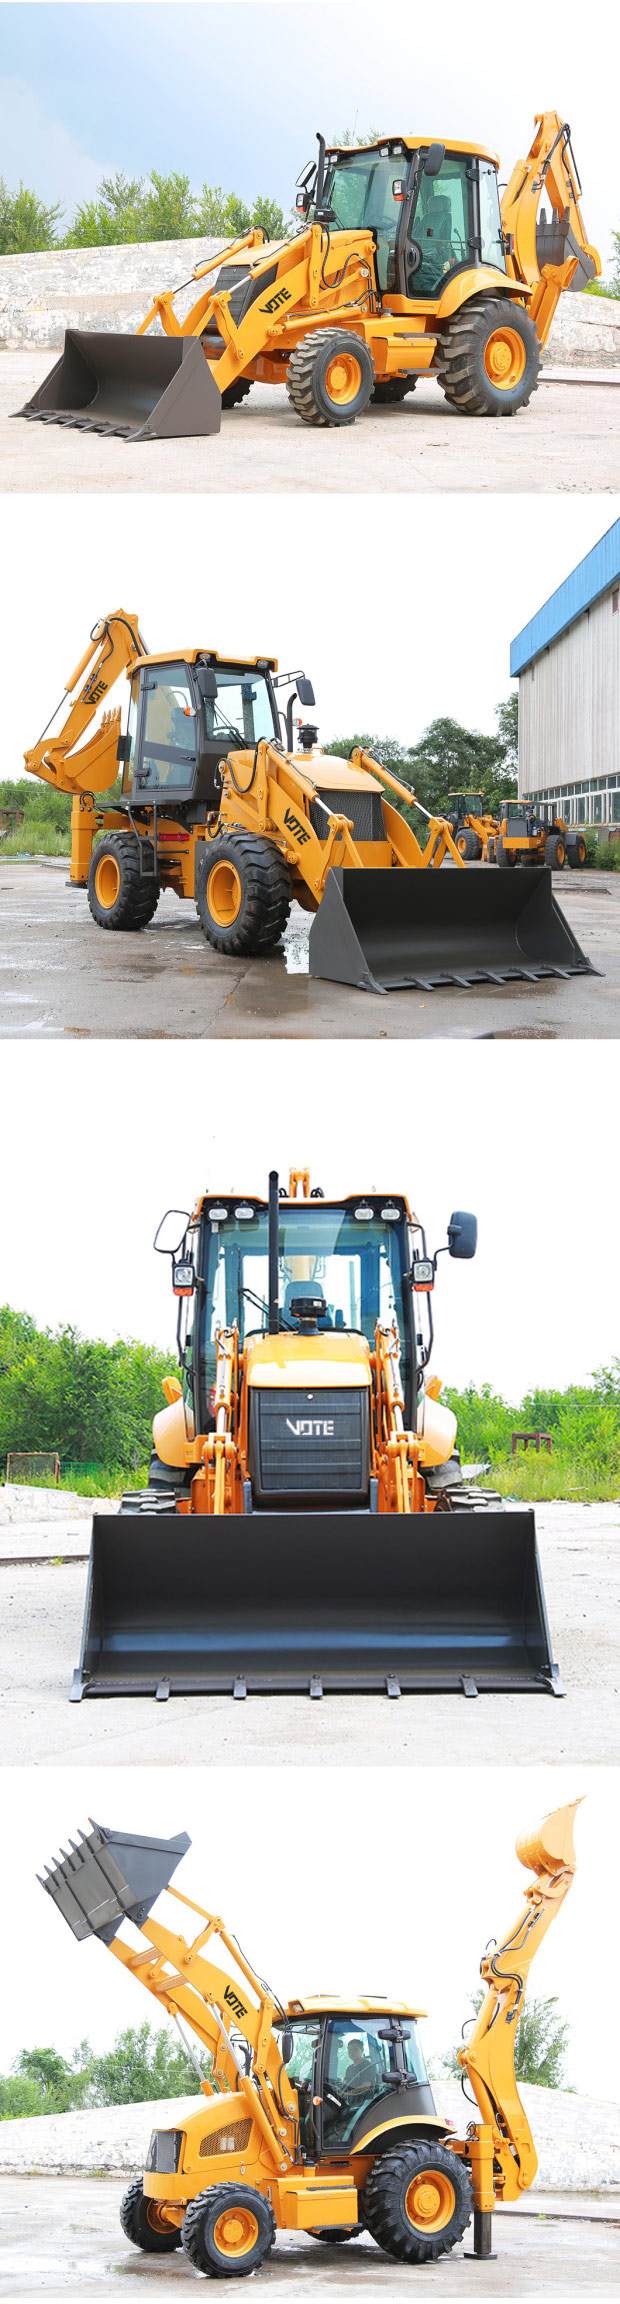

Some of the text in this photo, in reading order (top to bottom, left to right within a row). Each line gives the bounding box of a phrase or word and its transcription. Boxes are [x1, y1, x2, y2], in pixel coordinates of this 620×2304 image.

[258, 287, 292, 314] VOTE
[84, 680, 109, 704] VOTE
[283, 807, 311, 845] VOTE
[286, 1417, 334, 1436] VOTE
[223, 1984, 248, 2019] VOTE
